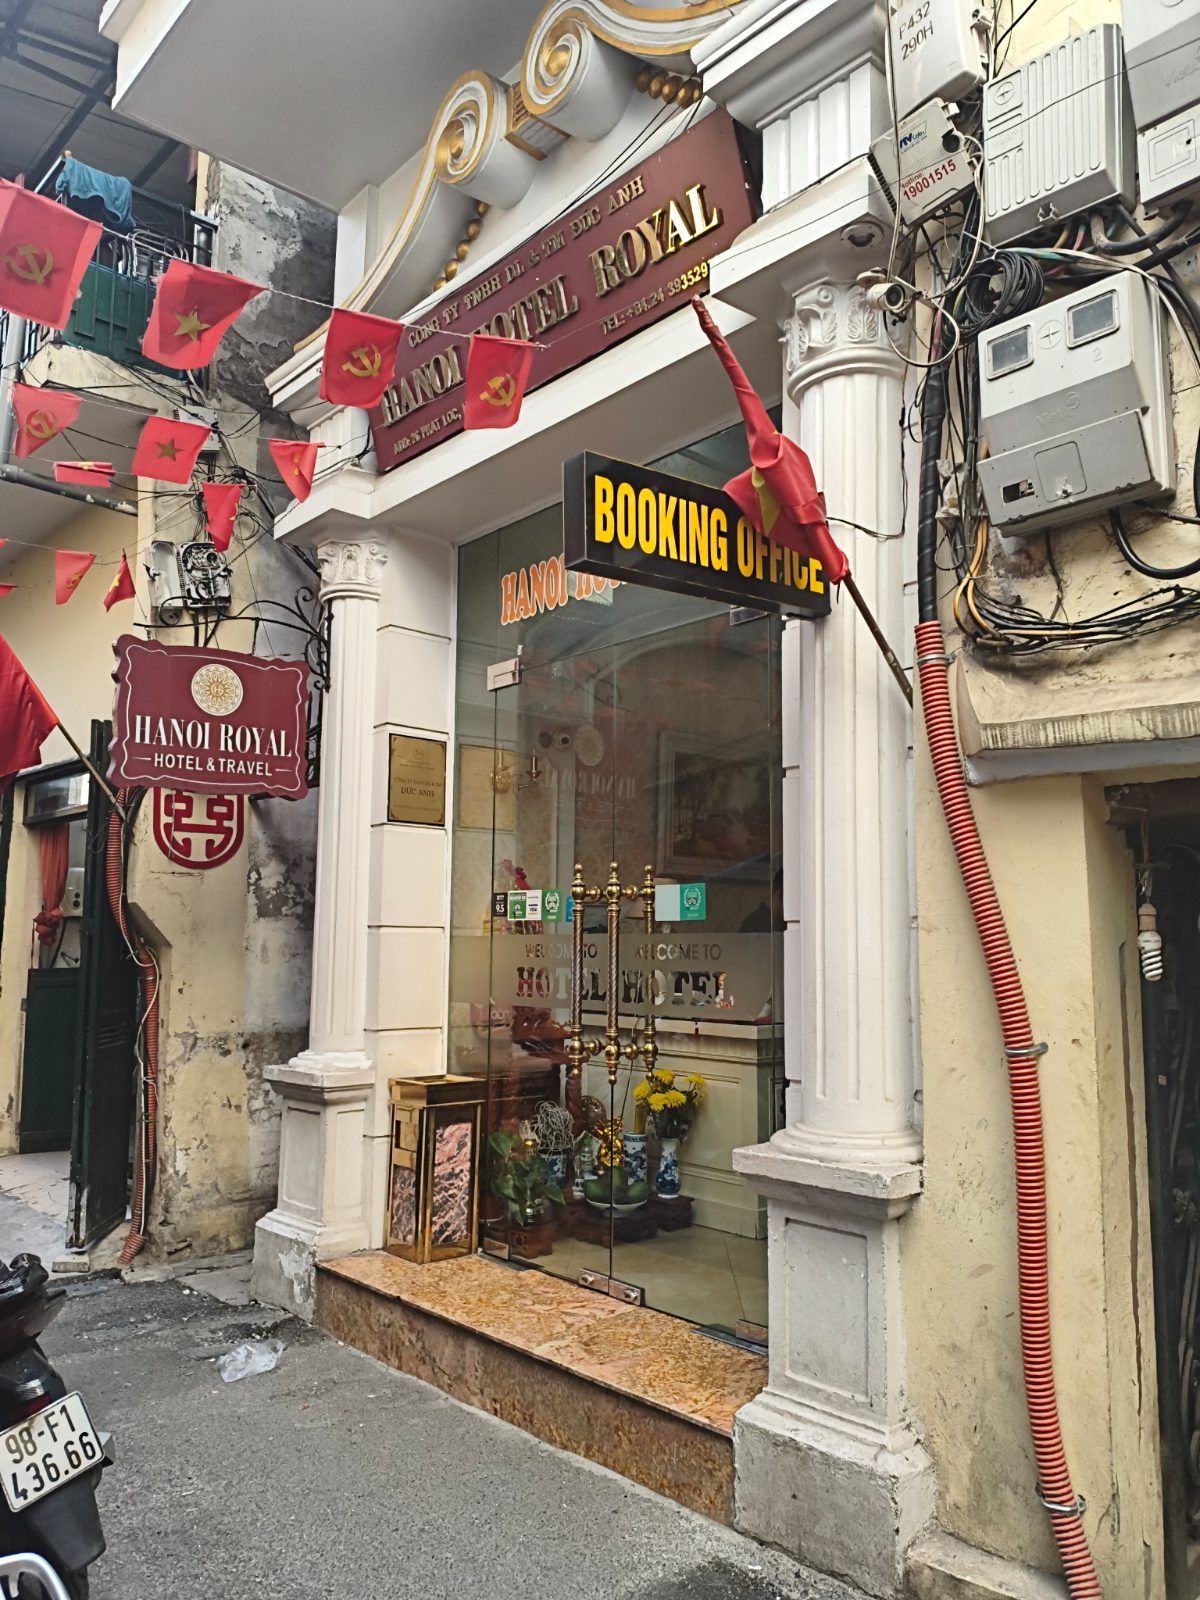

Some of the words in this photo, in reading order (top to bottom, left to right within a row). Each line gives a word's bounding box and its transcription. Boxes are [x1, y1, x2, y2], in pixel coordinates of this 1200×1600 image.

[901, 20, 934, 61] 290H
[903, 159, 956, 200] 19001515
[442, 301, 460, 325] TY
[464, 273, 502, 311] TNHH
[529, 249, 541, 268] &
[541, 229, 566, 258] TM
[608, 175, 646, 215] ANH
[380, 343, 464, 428] HANOI
[468, 273, 579, 342] OTEL
[588, 183, 720, 298] ROYAL
[600, 313, 626, 335] TEL:
[667, 261, 708, 297] 393529
[594, 474, 728, 572] BOOKING
[736, 515, 825, 595] OFFICE
[501, 552, 569, 625] HANOI
[134, 714, 211, 750] HANOI
[218, 723, 292, 757] ROYAL
[154, 752, 203, 771] HOTEL
[206, 757, 216, 772] &
[218, 758, 273, 777] TRAVEL
[526, 943, 573, 959] WELCOM
[632, 943, 700, 960] WELCOME
[703, 944, 722, 960] TO
[621, 969, 735, 1009] HOTEL
[5, 1405, 76, 1464] 98-F1
[11, 1431, 96, 1501] 436.66
